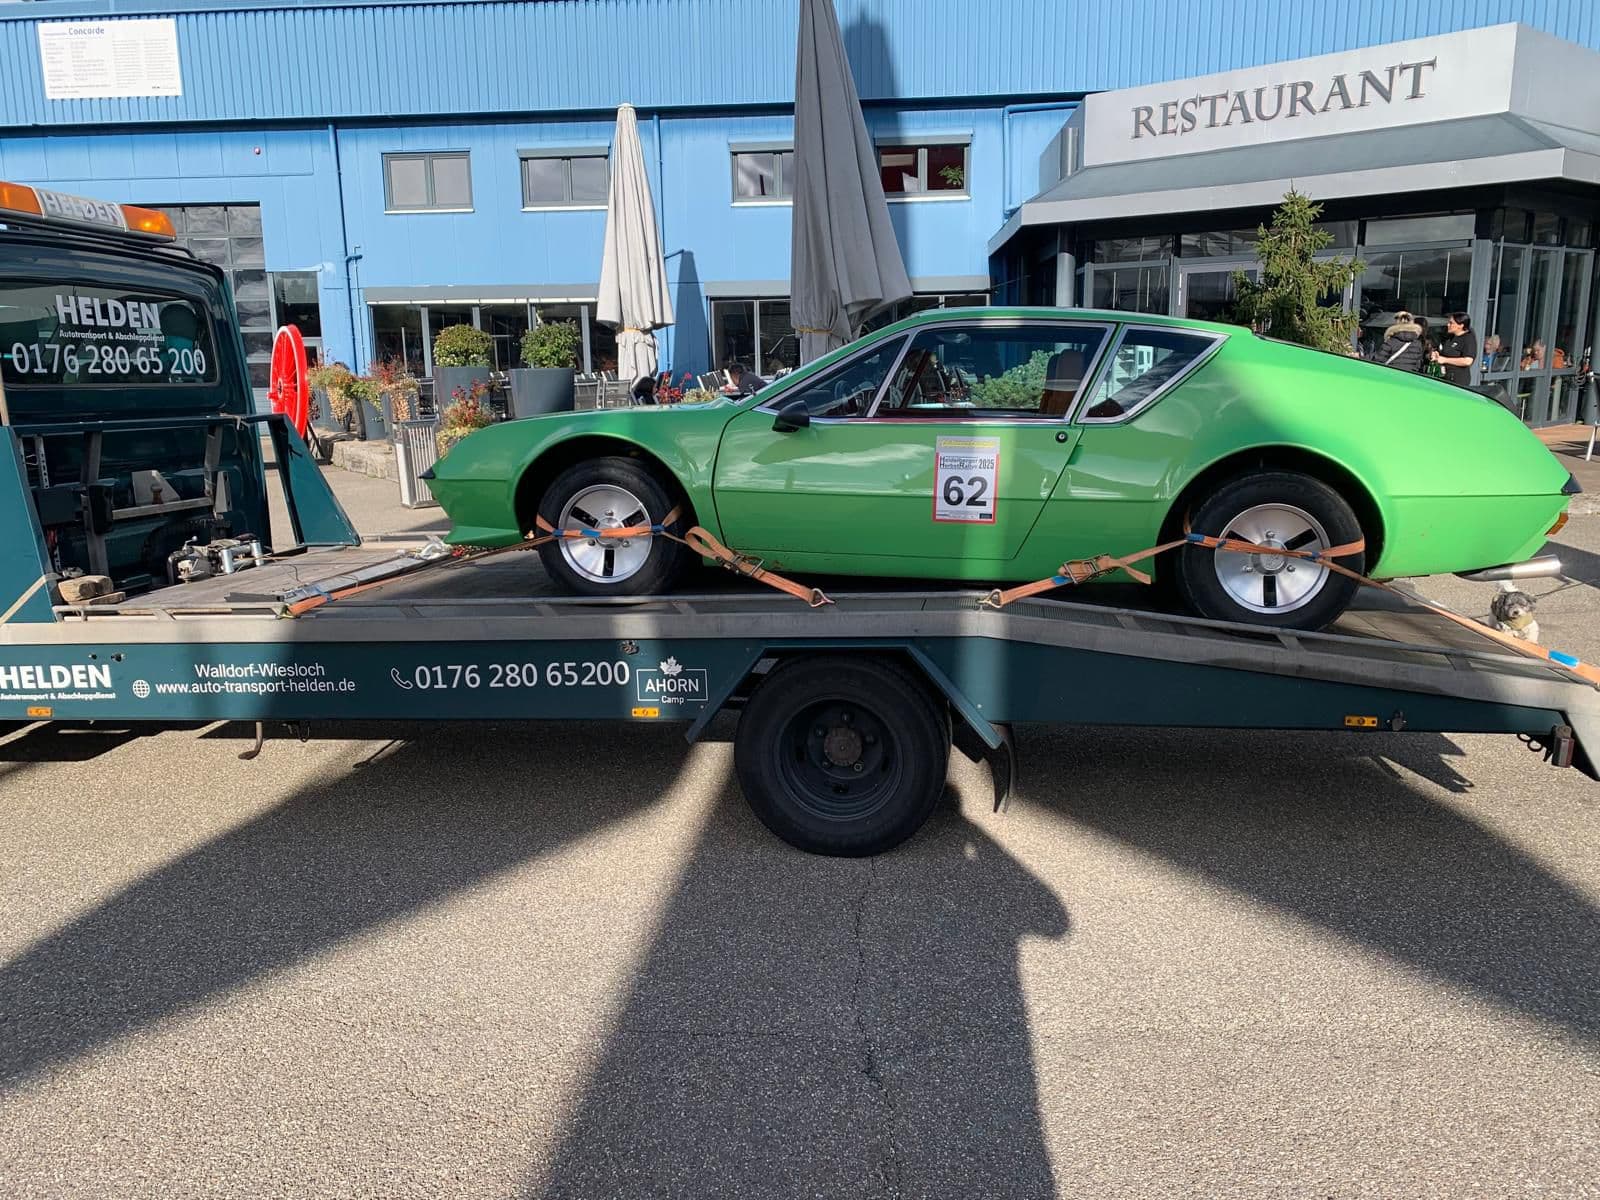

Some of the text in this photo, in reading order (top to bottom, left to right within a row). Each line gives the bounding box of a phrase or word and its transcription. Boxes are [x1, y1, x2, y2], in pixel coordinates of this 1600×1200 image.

[68, 26, 105, 35] Concorde
[1130, 56, 1437, 139] RESTAURANT
[40, 191, 121, 226] HELDEN
[56, 294, 161, 329] HELDEN
[60, 329, 165, 343] Autotransport & Abschleppdienst
[12, 342, 206, 375] 0176 280 65 200
[978, 458, 994, 469] 2025
[943, 475, 988, 506] 62
[0, 664, 112, 689] HELDEN
[194, 663, 325, 678] Walldorf-Wiesloch
[414, 661, 630, 690] 0176 280 65200
[155, 678, 356, 696] www.auto-transport-helden.de
[645, 678, 699, 693] AHORN
[661, 694, 685, 705] Camp
